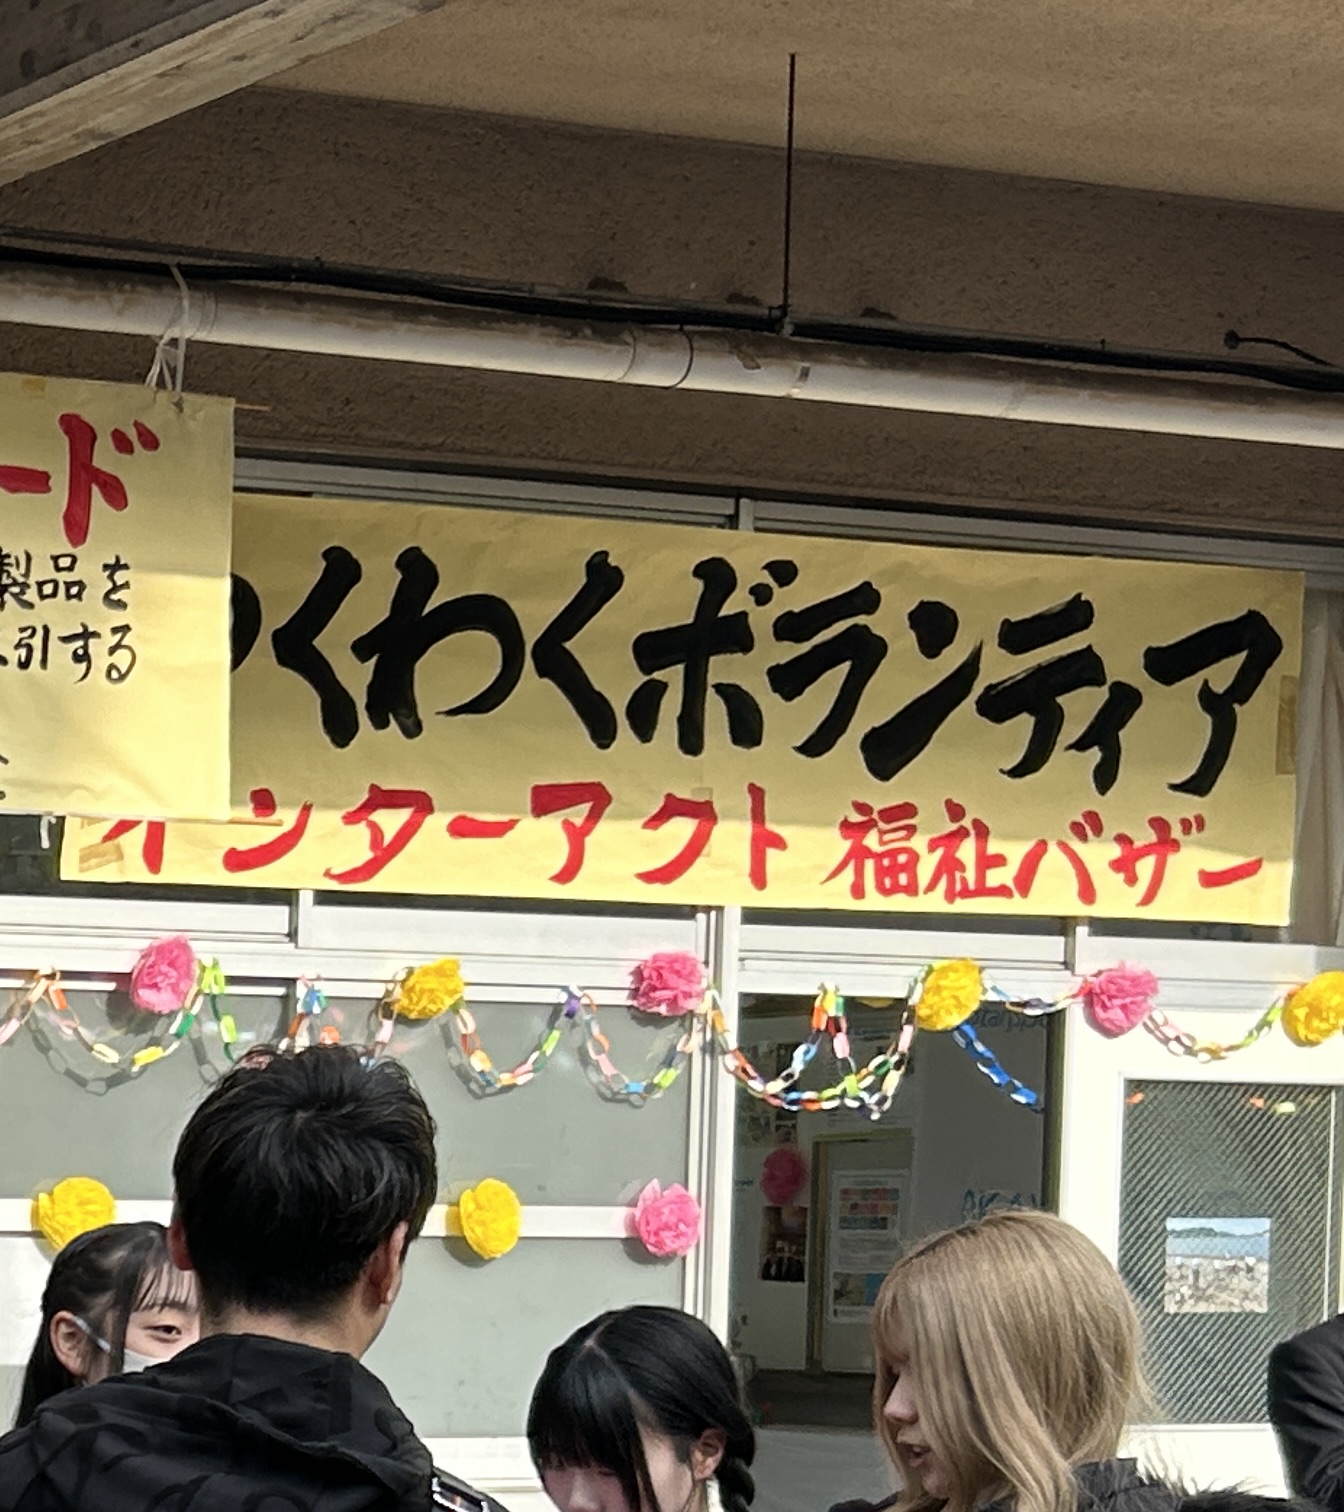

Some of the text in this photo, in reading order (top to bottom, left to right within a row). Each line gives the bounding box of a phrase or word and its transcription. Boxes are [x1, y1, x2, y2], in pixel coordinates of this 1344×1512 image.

[100, 782, 1265, 908] インターアクト 福祉バザー
